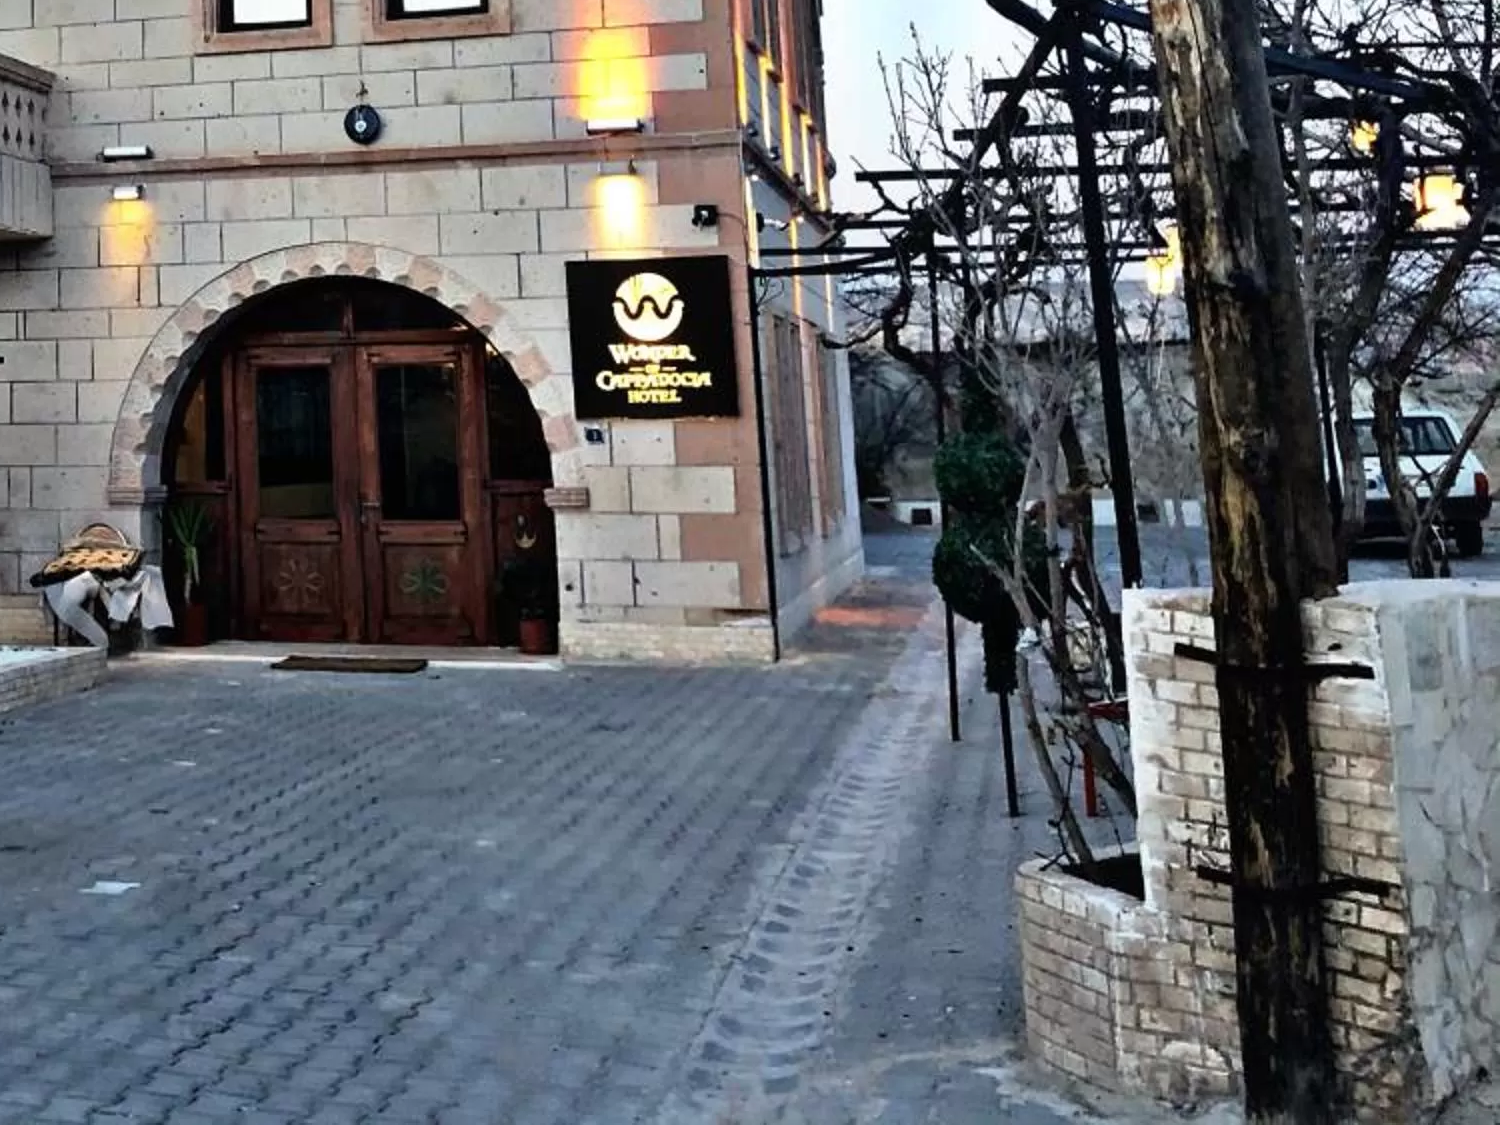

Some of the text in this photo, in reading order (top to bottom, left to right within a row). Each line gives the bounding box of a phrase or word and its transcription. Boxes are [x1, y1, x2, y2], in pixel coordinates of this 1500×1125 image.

[608, 344, 697, 364] WONDER
[595, 371, 712, 391] CAPPADOCIA
[628, 389, 682, 403] HOTEL
